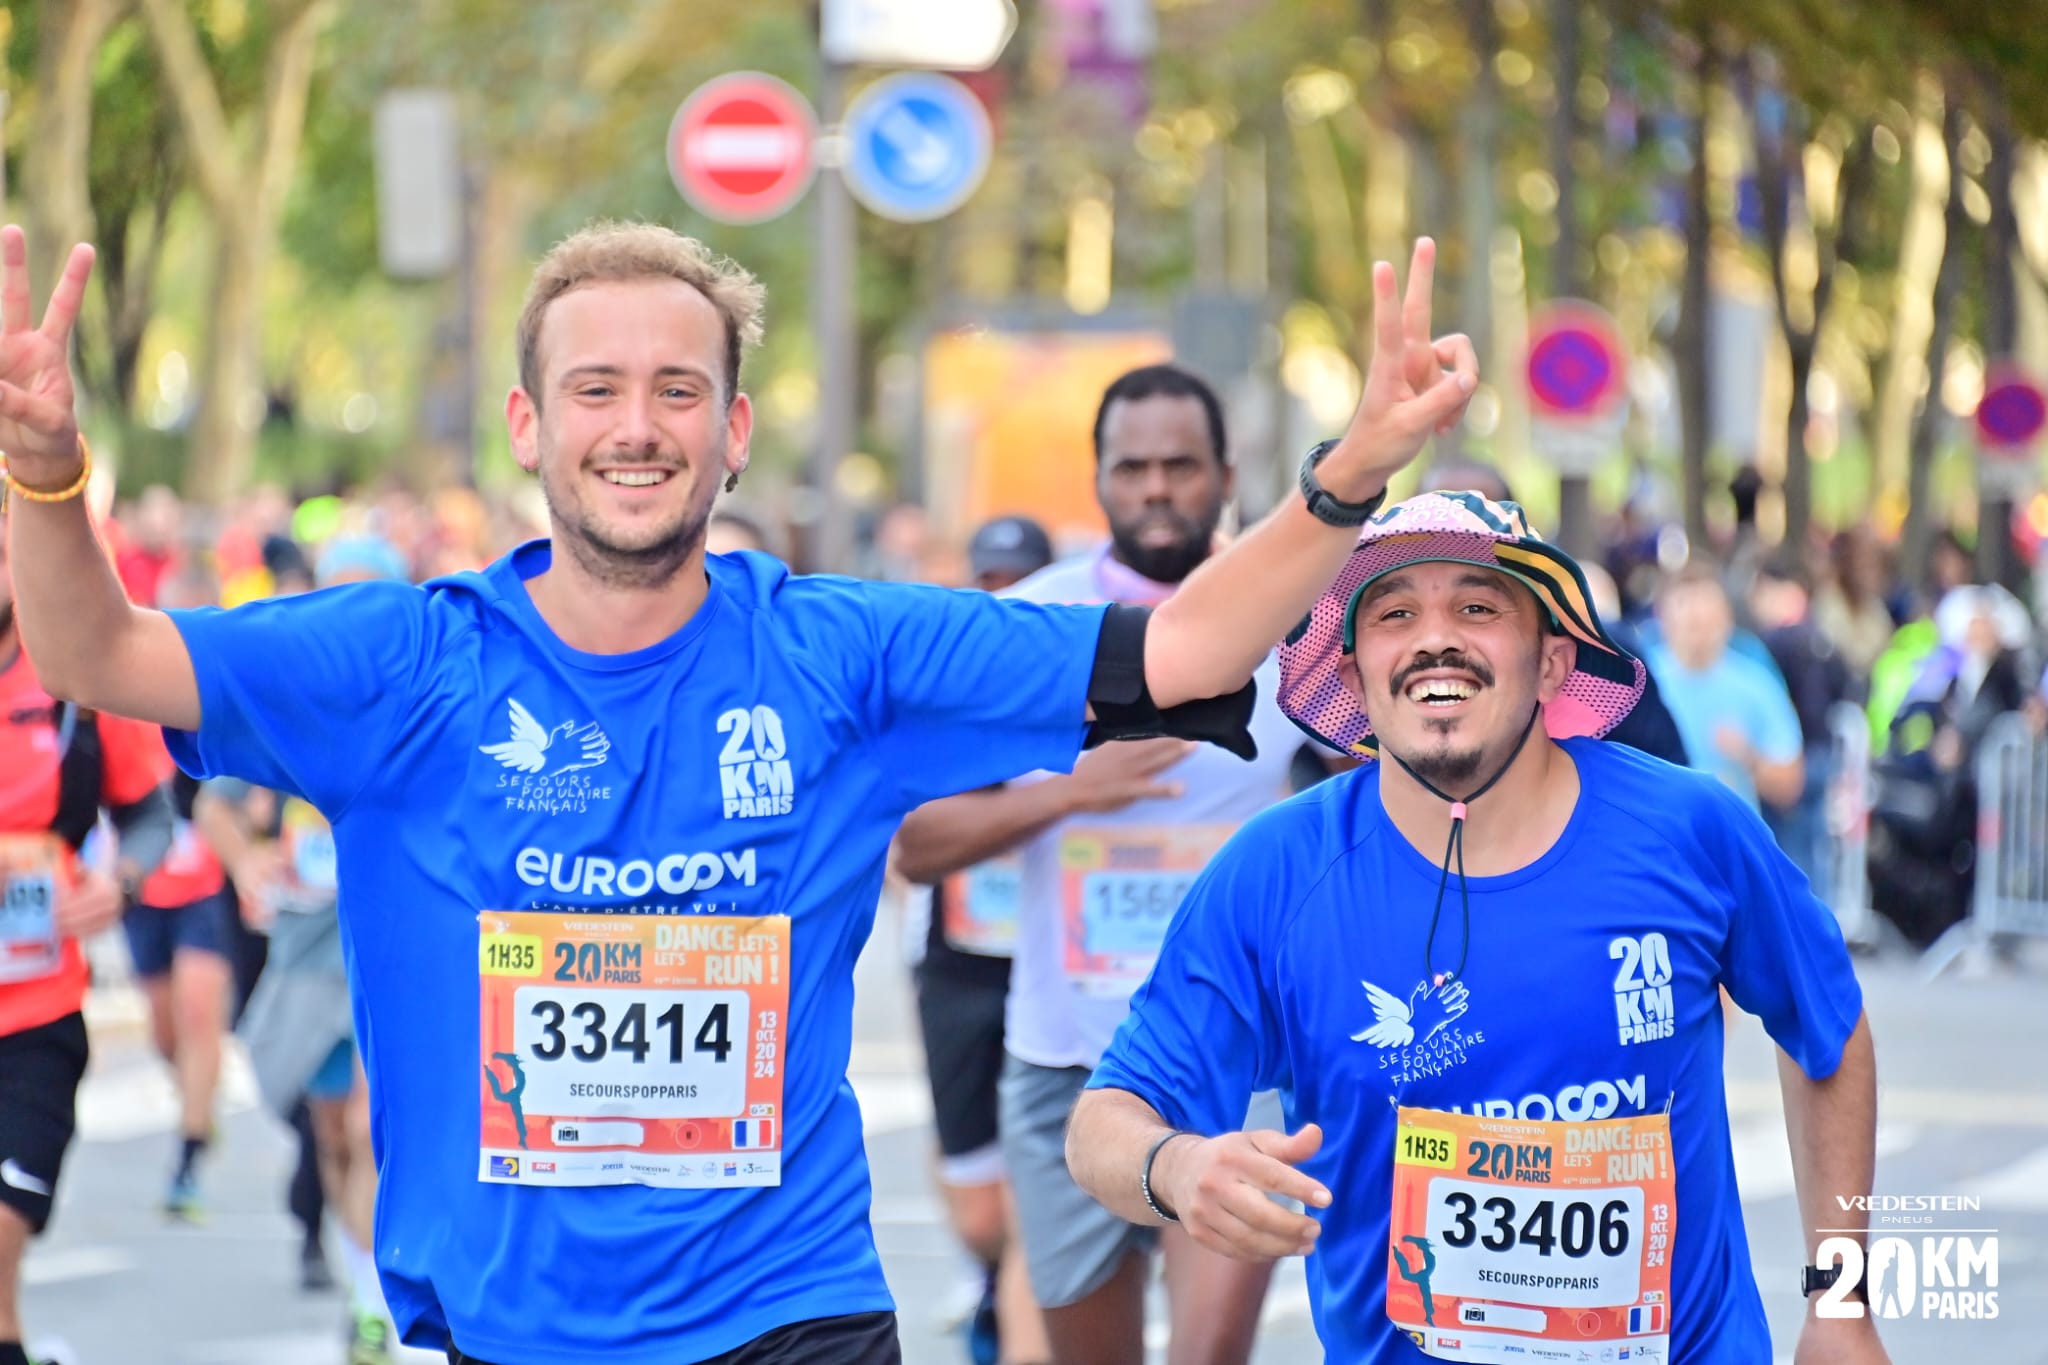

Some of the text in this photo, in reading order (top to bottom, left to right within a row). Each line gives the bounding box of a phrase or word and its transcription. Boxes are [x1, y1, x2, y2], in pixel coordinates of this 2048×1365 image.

[716, 704, 787, 767] 20
[496, 773, 591, 789] SECOURS
[719, 760, 794, 800] KM
[521, 785, 612, 801] POPULAIRE
[505, 796, 586, 816] FRANÇAIS
[723, 795, 794, 819] PARIS
[692, 902, 717, 914] VU
[655, 924, 779, 952] DANCE LET'S
[487, 943, 534, 969] 1H35
[554, 942, 642, 982] 20 KM
[654, 952, 686, 966] LET'S
[1608, 932, 1673, 993] 20
[604, 970, 641, 984] PARIS
[705, 954, 779, 985] RUN !
[1615, 984, 1675, 1028] KM
[530, 1000, 732, 1064] 33414
[758, 1011, 777, 1029] 13
[1619, 1018, 1675, 1046] PARIS
[756, 1030, 776, 1042] OCT.
[755, 1043, 776, 1060] 20
[1379, 1028, 1462, 1069] SECOURS
[1403, 1031, 1485, 1071] POPULAIRE
[753, 1060, 776, 1078] 24
[1391, 1052, 1467, 1087] FRANÇAIS
[569, 1083, 698, 1099] SECOURSPOPPARIS
[1404, 1135, 1449, 1162] 1H35
[1565, 1125, 1665, 1153] DANCE LET'S
[1467, 1141, 1552, 1180] 20 KM
[1563, 1154, 1592, 1167] LET'S
[1607, 1150, 1667, 1183] RUN !
[1515, 1169, 1551, 1183] PARIS
[1652, 1204, 1668, 1220] 13
[1442, 1192, 1630, 1258] 33406
[1651, 1222, 1668, 1233] OCT.
[1649, 1234, 1667, 1249] 20
[1647, 1251, 1664, 1267] 24
[1478, 1270, 1599, 1290] SECOURSPOPPARIS
